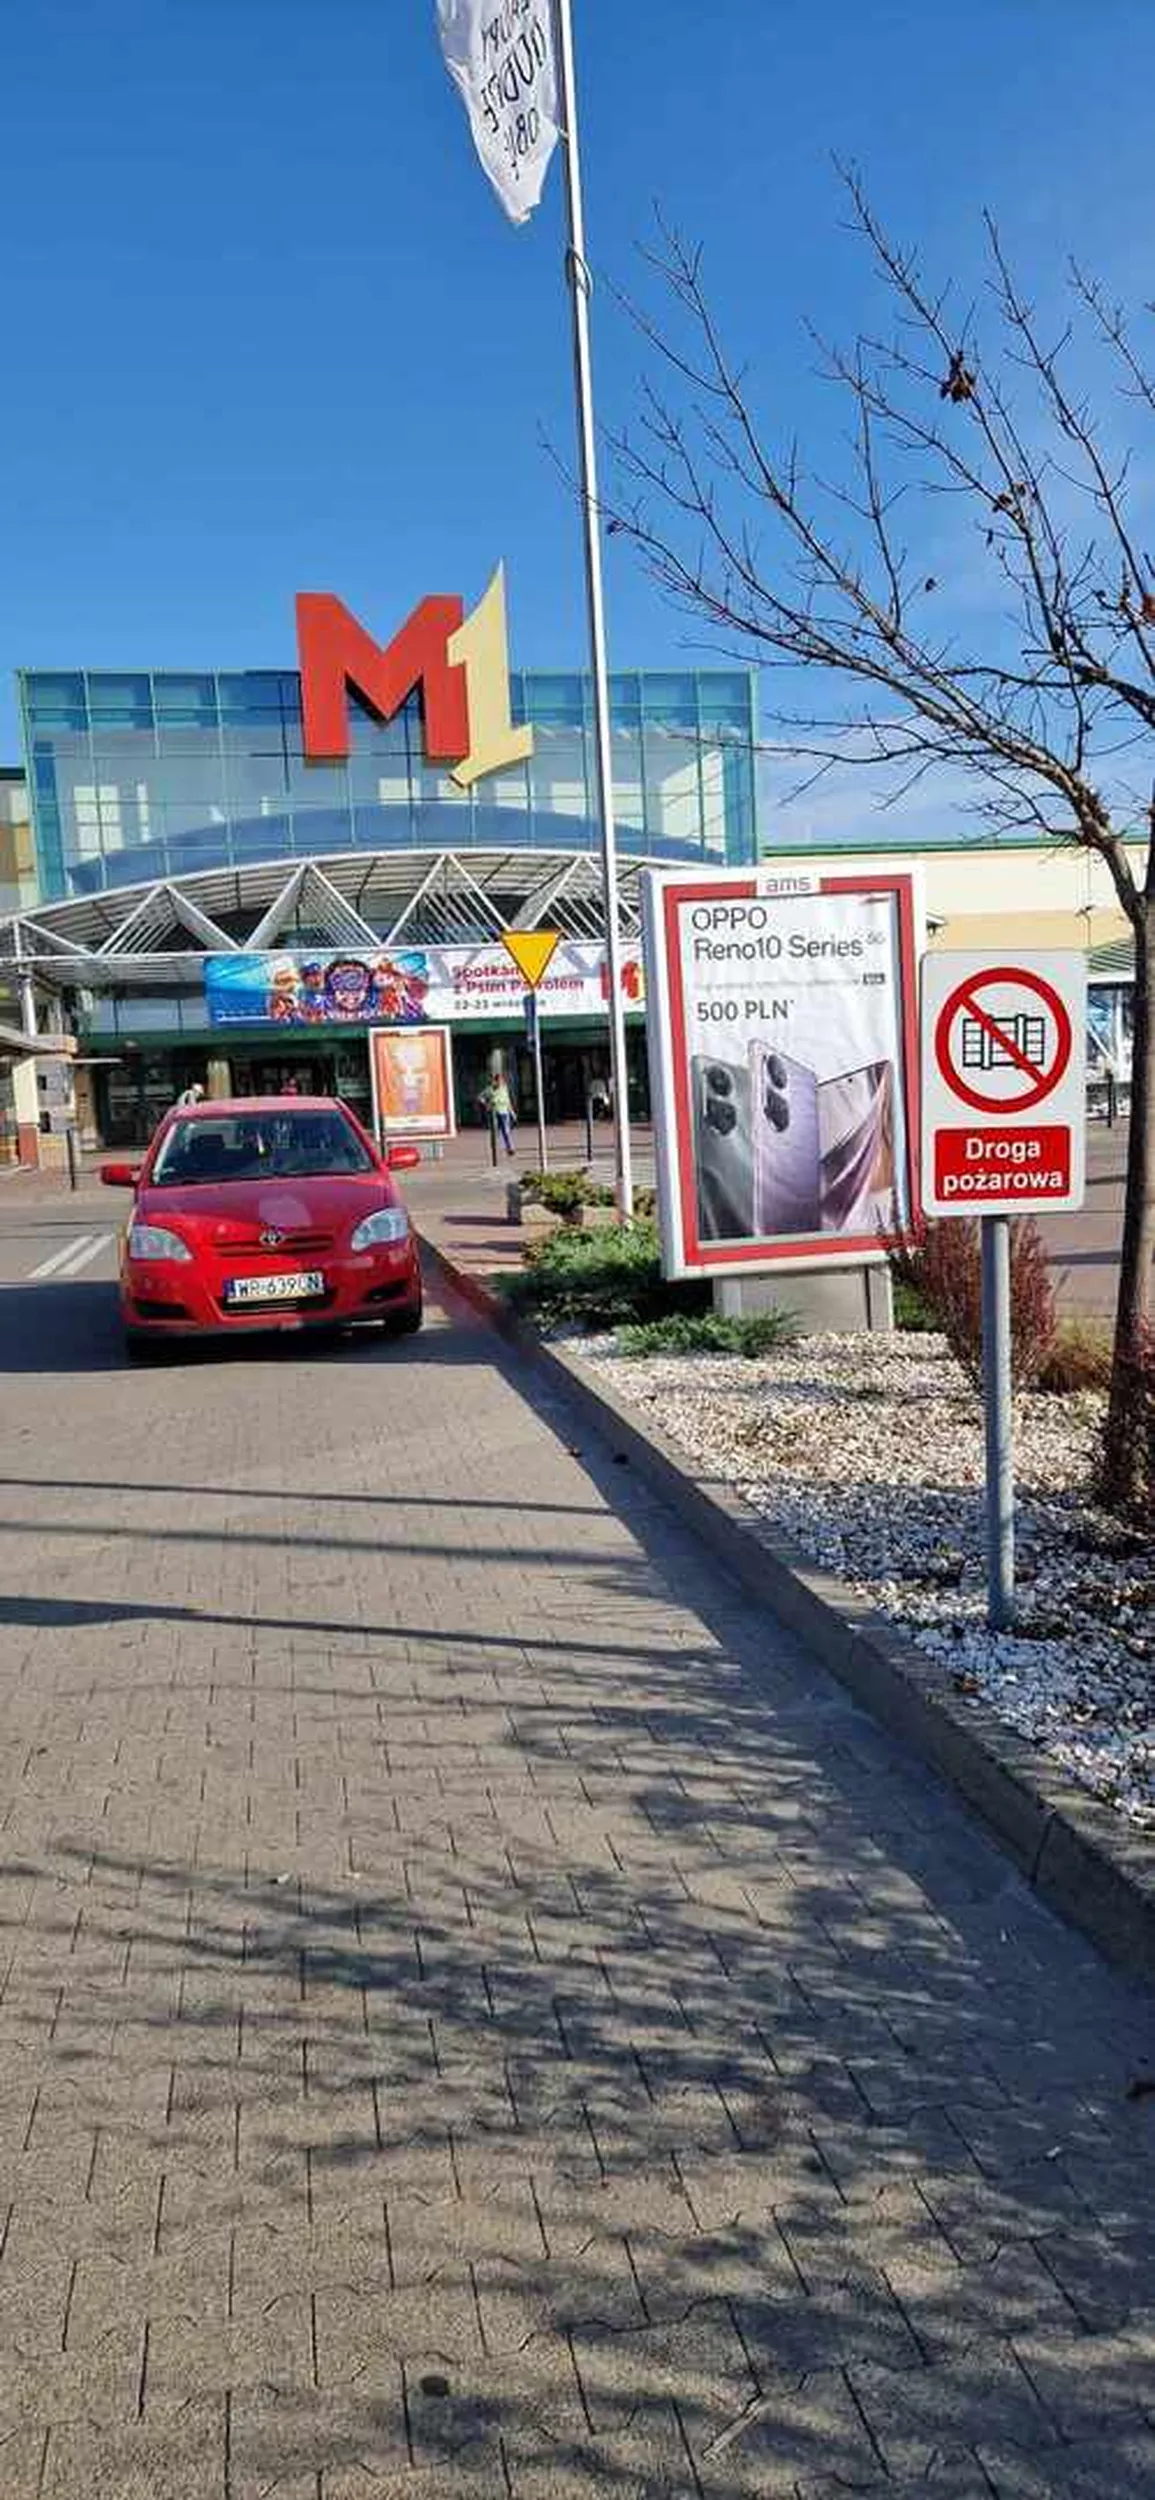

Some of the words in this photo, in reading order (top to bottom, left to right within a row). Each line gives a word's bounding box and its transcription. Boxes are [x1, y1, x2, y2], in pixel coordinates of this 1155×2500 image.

[295, 557, 533, 788] M1
[765, 876, 812, 893] ams
[691, 905, 768, 931] OPPO
[693, 934, 782, 962] Reno10
[787, 932, 864, 959] Series
[511, 977, 584, 992] Parolem
[696, 1000, 739, 1022] 500
[965, 1137, 1042, 1163] Droga
[943, 1167, 1064, 1197] pożarowa
